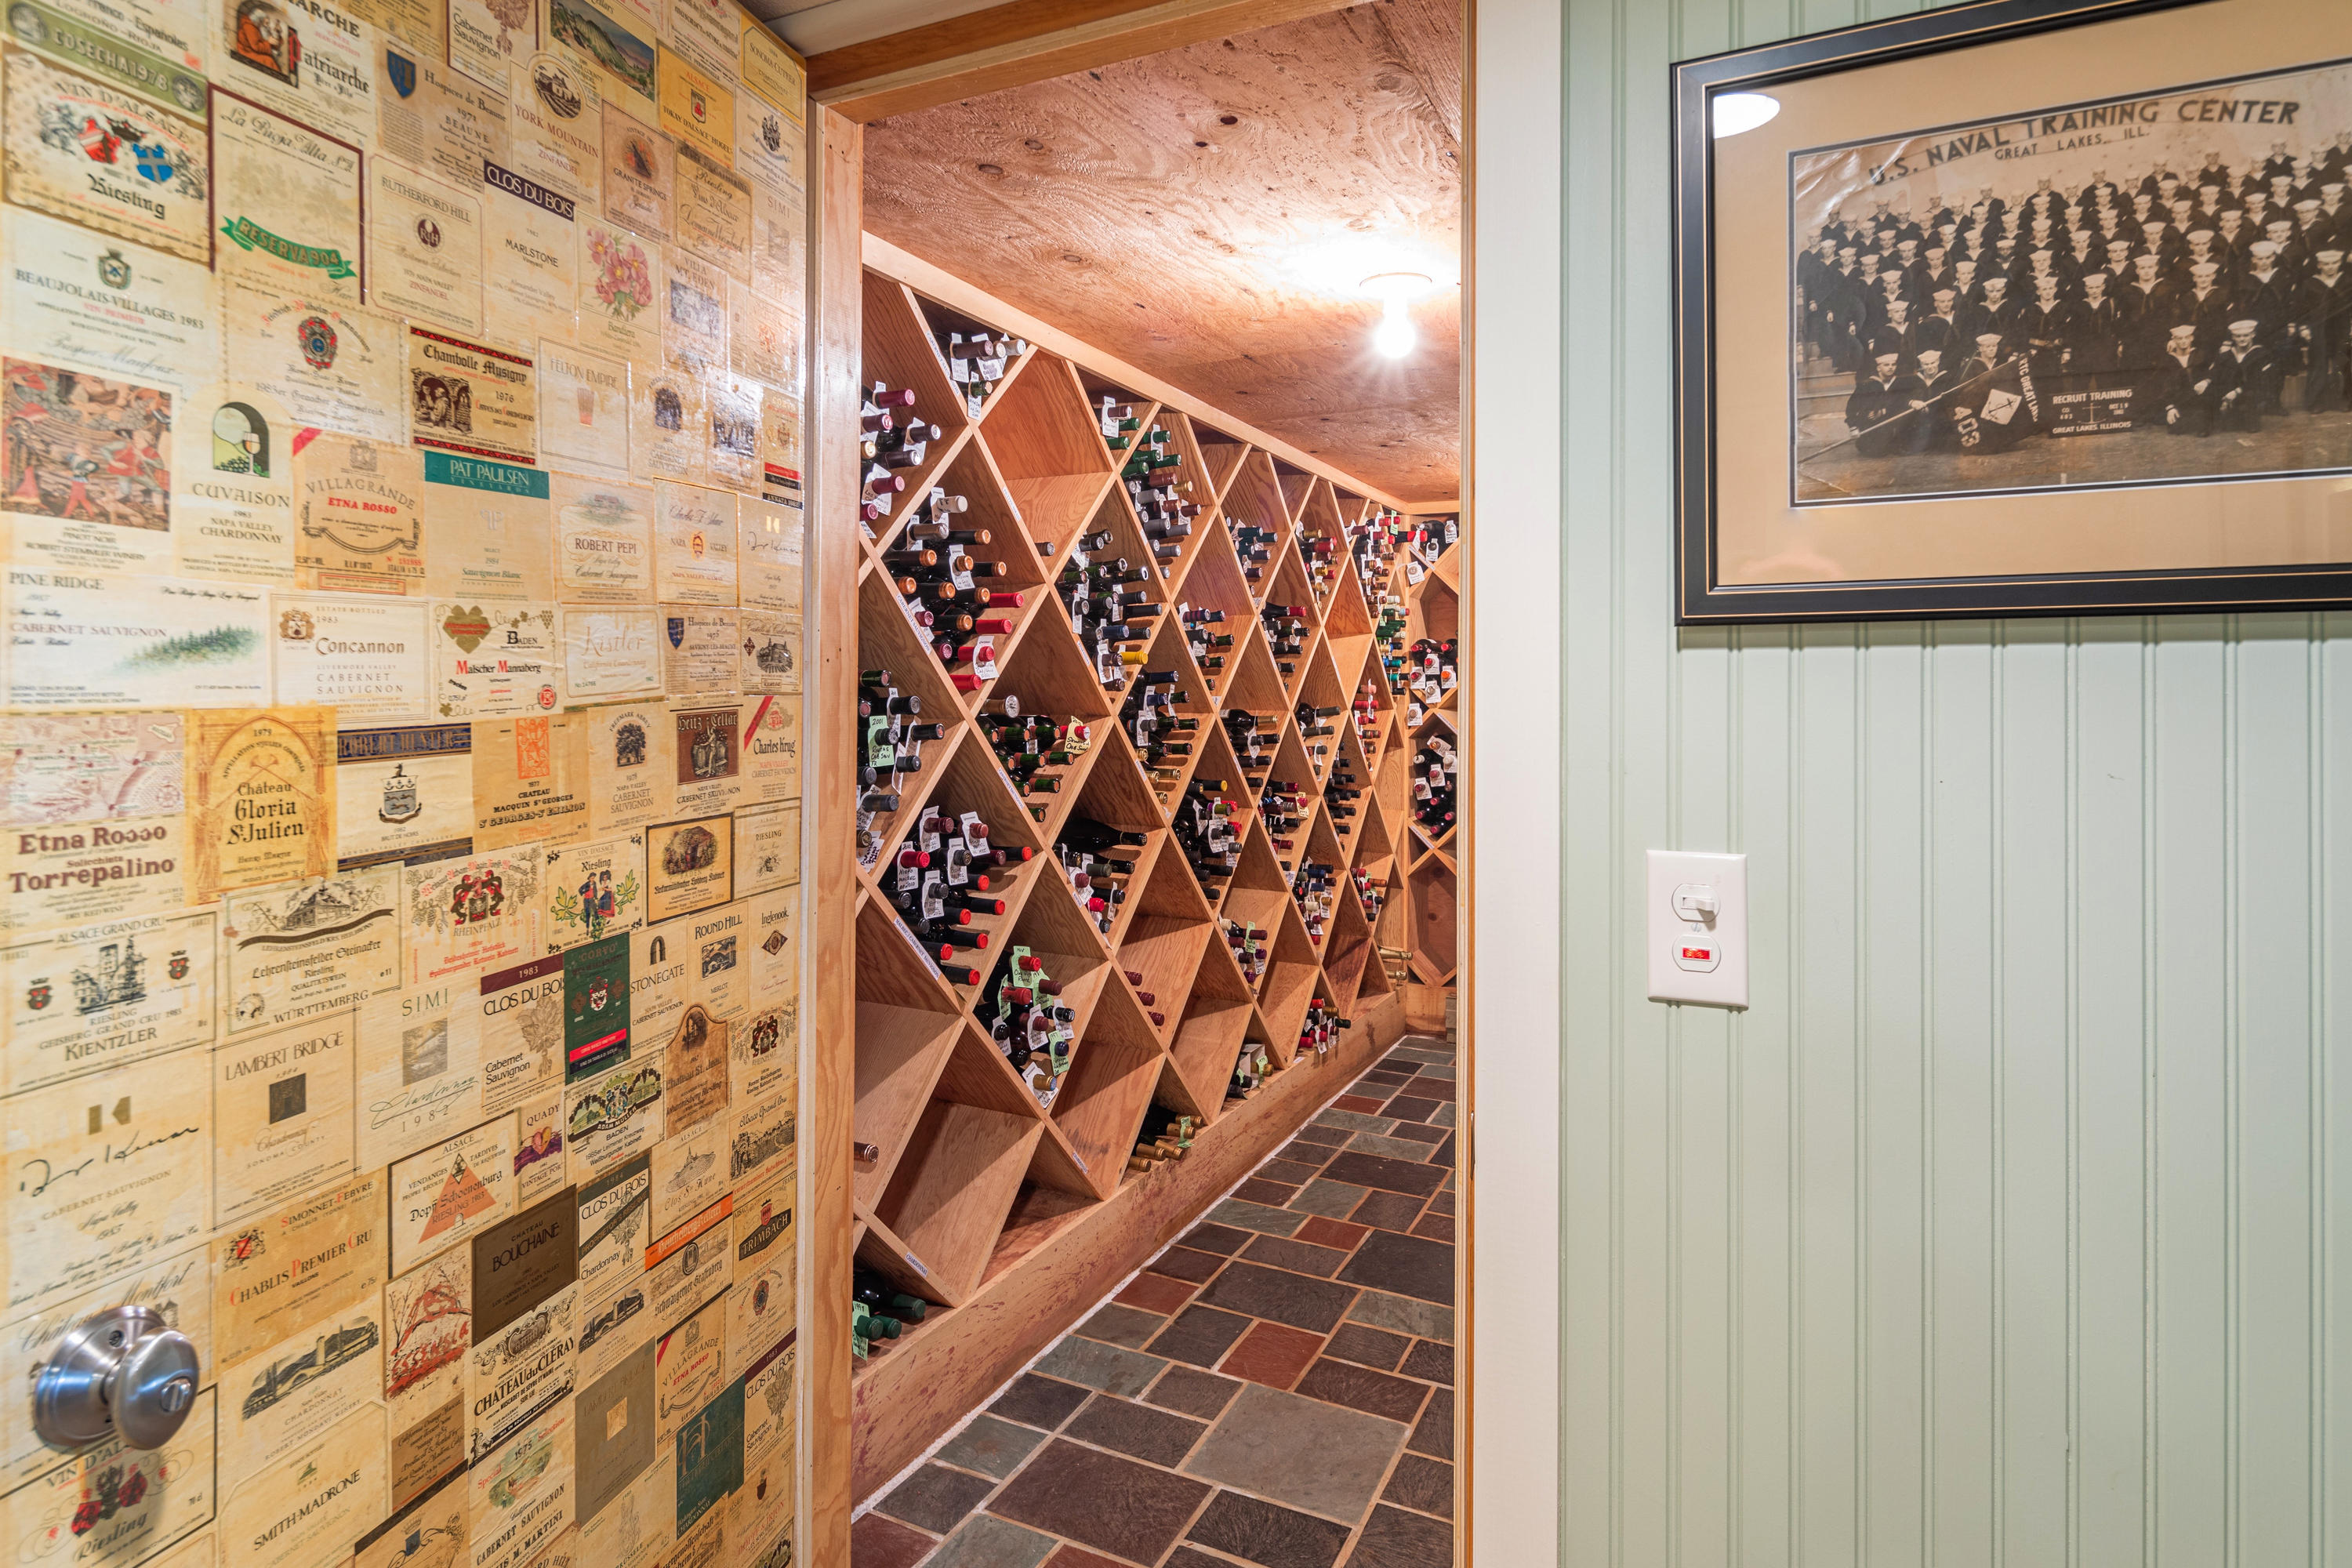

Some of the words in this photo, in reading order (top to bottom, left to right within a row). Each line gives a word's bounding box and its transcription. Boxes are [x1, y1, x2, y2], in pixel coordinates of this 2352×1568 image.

[287, 0, 361, 38] ARCHE
[453, 14, 493, 45] Cabernet
[454, 25, 502, 61] Sauvignon
[53, 27, 130, 75] COSECHA
[129, 62, 170, 93] 1978
[288, 26, 370, 94] Patriarche
[424, 70, 463, 100] Hospices
[465, 93, 475, 103] de
[477, 96, 506, 122] Beaune
[514, 104, 545, 129] YORK
[547, 122, 599, 158] MOUNTAIN
[1868, 158, 1919, 186] U.S.
[1926, 127, 2011, 166] NAVAL
[2022, 99, 2159, 140] TRAINING
[2178, 99, 2300, 125] CENTER
[1994, 142, 2038, 162] GREAT
[2123, 127, 2151, 140] ILL.
[87, 172, 166, 220] Riesling
[487, 165, 521, 194] CLOS
[524, 186, 543, 204] DU
[545, 195, 574, 218] BOIS
[614, 168, 642, 187] GRANITE
[643, 179, 667, 201] SPRINGS
[382, 176, 449, 214] RUTHERFORD
[451, 207, 471, 223] HILL
[238, 220, 310, 266] RESERVA
[311, 249, 340, 267] 904
[505, 238, 559, 267] MARLSTONE
[15, 269, 176, 321] BEAUJOLAIS-VILLAGES
[423, 343, 479, 372] Chambolle
[482, 360, 528, 387] Musigny
[550, 358, 585, 381] FELTON
[586, 368, 618, 390] EMPIRE
[2020, 375, 2037, 401] GREAT
[2053, 393, 2087, 405] RECRUIT
[2089, 389, 2134, 401] TRAINING
[1953, 406, 1982, 448] 403
[2052, 426, 2076, 434] GREAT
[2100, 420, 2132, 430] ILLINOIS
[450, 459, 474, 478] PAT
[477, 464, 529, 486] PAULSEN
[192, 482, 290, 509] CUVAISON
[306, 477, 416, 510] VILLAGRANDE
[328, 497, 359, 510] ETNA
[362, 502, 398, 514] ROSSO
[201, 526, 283, 544] CHARDONNAY
[211, 517, 236, 528] NAPA
[239, 520, 275, 532] VALLEY
[575, 538, 613, 553] ROBERT
[617, 542, 637, 554] PEPI
[9, 572, 51, 586] PINE
[53, 575, 105, 590] RIDGE
[462, 567, 501, 579] Sauvignon
[503, 569, 522, 579] Blanc
[10, 622, 85, 636] CABERNET
[90, 626, 169, 638] SAUVIGNON
[506, 630, 538, 645] BADEN
[581, 625, 646, 657] Kistler
[316, 637, 405, 657] Concannon
[317, 673, 390, 683] CABERNET
[456, 660, 495, 675] Malscher
[497, 660, 542, 674] Mannaberg
[317, 684, 403, 695] SAUVIGNON
[677, 717, 702, 731] Heitz
[711, 713, 738, 728] Cellar
[753, 738, 779, 757] Charles
[779, 738, 796, 758] Krug
[238, 782, 292, 797] Château
[518, 789, 550, 799] CHATEAU
[613, 789, 652, 804] CABERNET
[677, 793, 706, 804] CABERNET
[235, 799, 296, 821] Gloria
[611, 797, 654, 814] SAUVIGNON
[18, 833, 85, 855] Etna
[93, 826, 167, 848] Rosso
[756, 829, 782, 841] RIESLING
[9, 858, 176, 894] Torrepalino
[581, 858, 612, 873] Riesling
[453, 920, 502, 937] RHEINPFALZ
[695, 919, 724, 940] ROUND
[724, 914, 742, 930] HILL
[761, 906, 789, 925] Inglenook
[57, 927, 100, 944] ALSACE
[102, 921, 141, 935] GRAND
[143, 917, 165, 929] CRU
[304, 965, 336, 979] Riesling
[518, 965, 539, 978] 1983
[630, 964, 684, 993] STONEGATE
[484, 991, 519, 1017] CLOS
[521, 983, 541, 1004] DU
[710, 982, 728, 994] MERLOT
[274, 989, 370, 1025] WÜRTTEMBERG
[402, 988, 448, 1017] SIMI
[89, 1008, 138, 1026] RIESLING
[633, 1011, 656, 1025] CABERNET
[65, 1027, 158, 1062] KIENTZLER
[226, 1047, 289, 1080] LAMBERT
[294, 1031, 344, 1059] BRIDGE
[485, 1052, 524, 1073] Cabernet
[485, 1061, 531, 1085] Sauvignon
[526, 1104, 561, 1127] QUADY
[442, 1134, 474, 1154] ALSACE
[606, 1125, 629, 1142] BADEN
[470, 1143, 499, 1162] TARDIVES
[408, 1167, 448, 1189] VENDANGES
[521, 1171, 549, 1189] VINTAGE
[42, 1193, 103, 1221] CABERNET
[105, 1171, 172, 1198] SAUVIGNON
[281, 1181, 375, 1229] SIMONNET-FEBVRE
[582, 1196, 608, 1220] CLOS
[609, 1187, 623, 1205] DU
[625, 1174, 646, 1194] BOIS
[511, 1219, 544, 1242] CHATEAU
[742, 1213, 789, 1254] TRIMBACH
[493, 1221, 560, 1272] BOUCHAINE
[230, 1269, 290, 1307] CHABLIS
[292, 1243, 347, 1278] PREMIER
[347, 1229, 373, 1250] CRU
[581, 1250, 621, 1280] Chardonnay
[662, 1338, 720, 1387] VILLAGRANDE
[673, 1369, 689, 1386] ETNA
[690, 1352, 710, 1374] ROSSO
[746, 1377, 766, 1399] CLOS
[767, 1366, 779, 1381] DU
[779, 1348, 796, 1369] BOIS
[474, 1367, 527, 1417] CHATEAU
[538, 1336, 574, 1371] CLERAY
[520, 1394, 528, 1406] SUR
[254, 1468, 361, 1552] SMITH-MADRONE
[477, 1526, 517, 1566] CABERNET
[521, 1483, 565, 1528] SAUVIGNON
